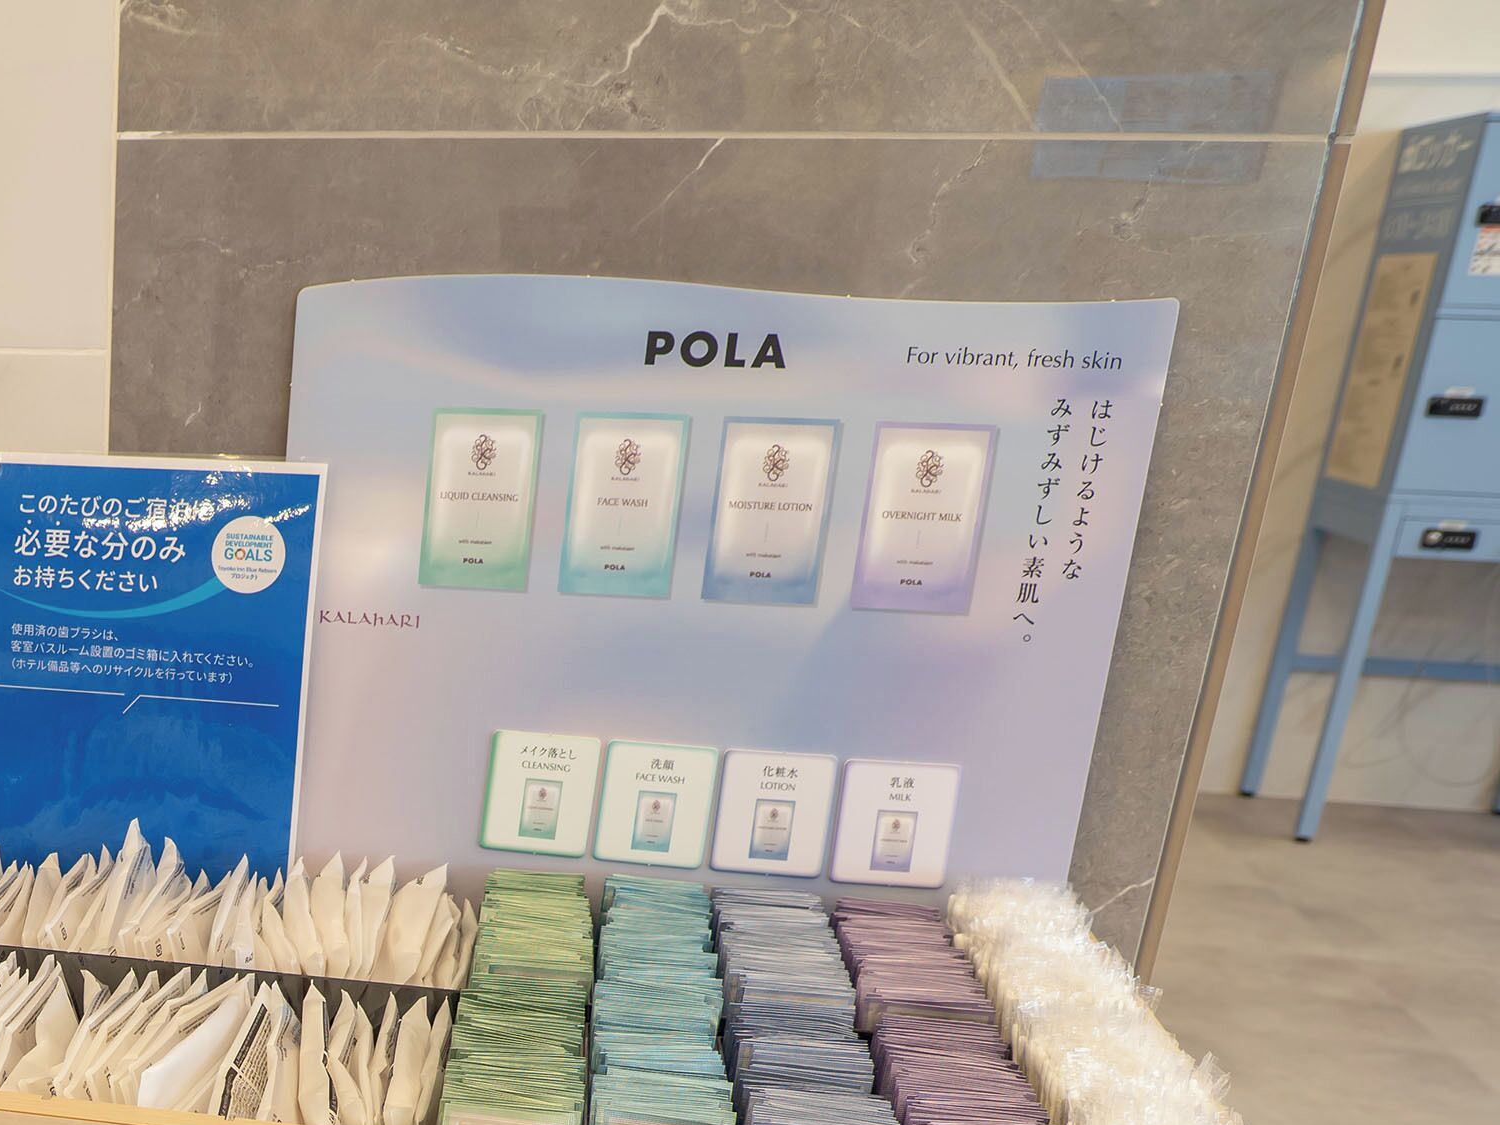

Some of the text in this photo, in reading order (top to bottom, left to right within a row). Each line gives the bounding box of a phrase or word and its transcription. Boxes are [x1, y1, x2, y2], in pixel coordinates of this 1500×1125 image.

[644, 330, 786, 370] POLA
[907, 346, 1123, 370] For vibrant, fresh skin
[1062, 399, 1113, 580] はじけるような
[439, 491, 519, 502] LIQUID CLEANSING
[597, 497, 649, 507] FACE WASH
[728, 501, 813, 511] MOISTURE LOTION
[882, 510, 964, 522] OVERNIGHT MILK
[1012, 398, 1072, 643] みずみずしい素肌へ。
[226, 533, 274, 541] SUSTAINABLE
[14, 527, 186, 563] 必要な分のみ
[225, 540, 273, 549] DEVELOPMENT
[224, 548, 273, 562] GOALS
[13, 564, 158, 593] お持ちください
[900, 578, 923, 586] POLA
[11, 623, 119, 642] 使用済の歯ブラシは、
[10, 640, 254, 669] 客室バスルーム設置のゴミ箱に入れてください。
[520, 745, 578, 761] メイク落とし
[521, 760, 572, 773] CLEANSING
[651, 758, 676, 771] 洗顔
[635, 772, 686, 785] FACE WASH
[763, 765, 799, 779] 化粧水
[760, 781, 797, 792] LOTION
[890, 776, 916, 790] 乳液
[889, 792, 912, 802] MILK
